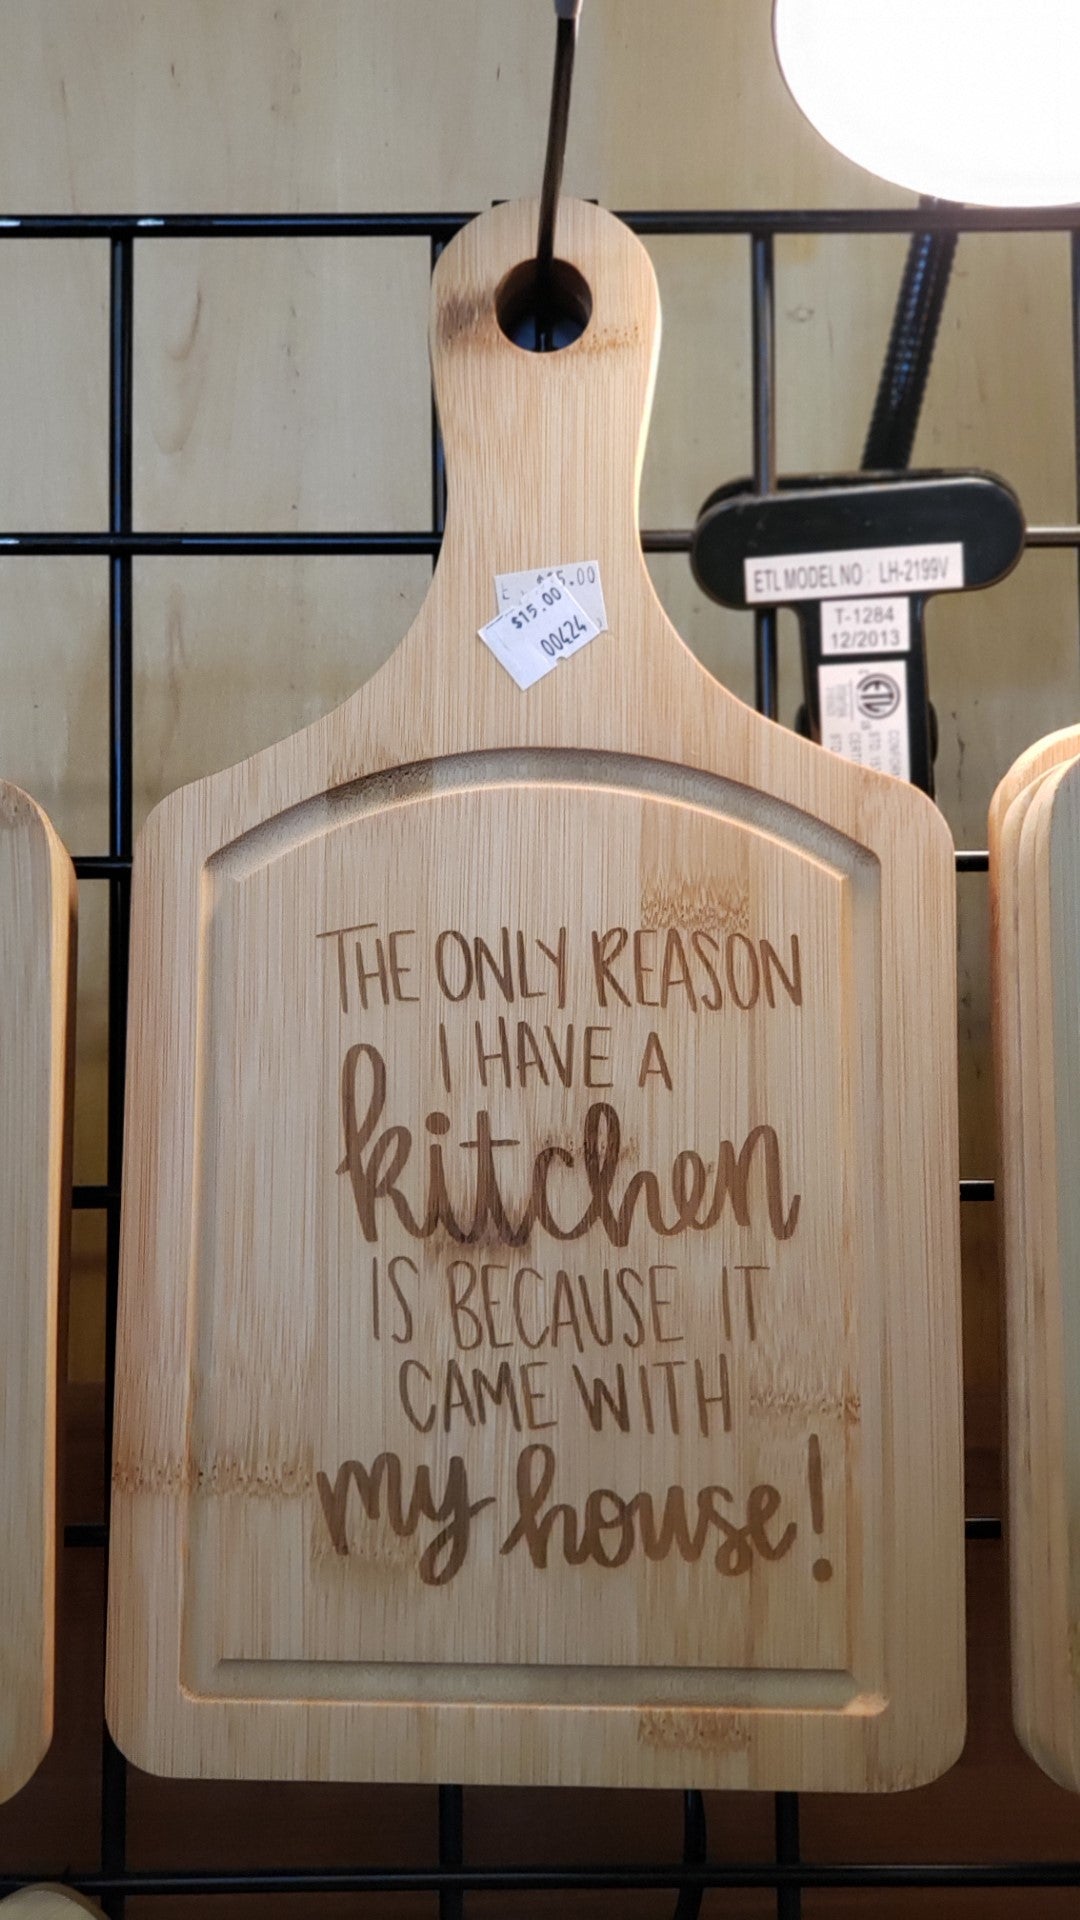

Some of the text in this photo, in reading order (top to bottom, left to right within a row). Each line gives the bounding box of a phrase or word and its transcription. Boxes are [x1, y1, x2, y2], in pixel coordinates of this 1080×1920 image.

[511, 586, 562, 629] $15.00
[754, 569, 782, 593] ETL
[785, 565, 837, 590] MODEL
[879, 556, 949, 584] LH-2199V
[540, 614, 587, 657] 00424
[831, 629, 900, 649] 12/2013
[835, 607, 895, 625] T-1284
[316, 923, 802, 1013] THE ONLY REASON
[439, 1016, 674, 1093] I HAVE A
[336, 1043, 802, 1249] kitchen
[372, 1255, 770, 1353] IS BECAUSE IT
[399, 1353, 732, 1437] CAME WITH
[316, 1433, 834, 1586] my house!
